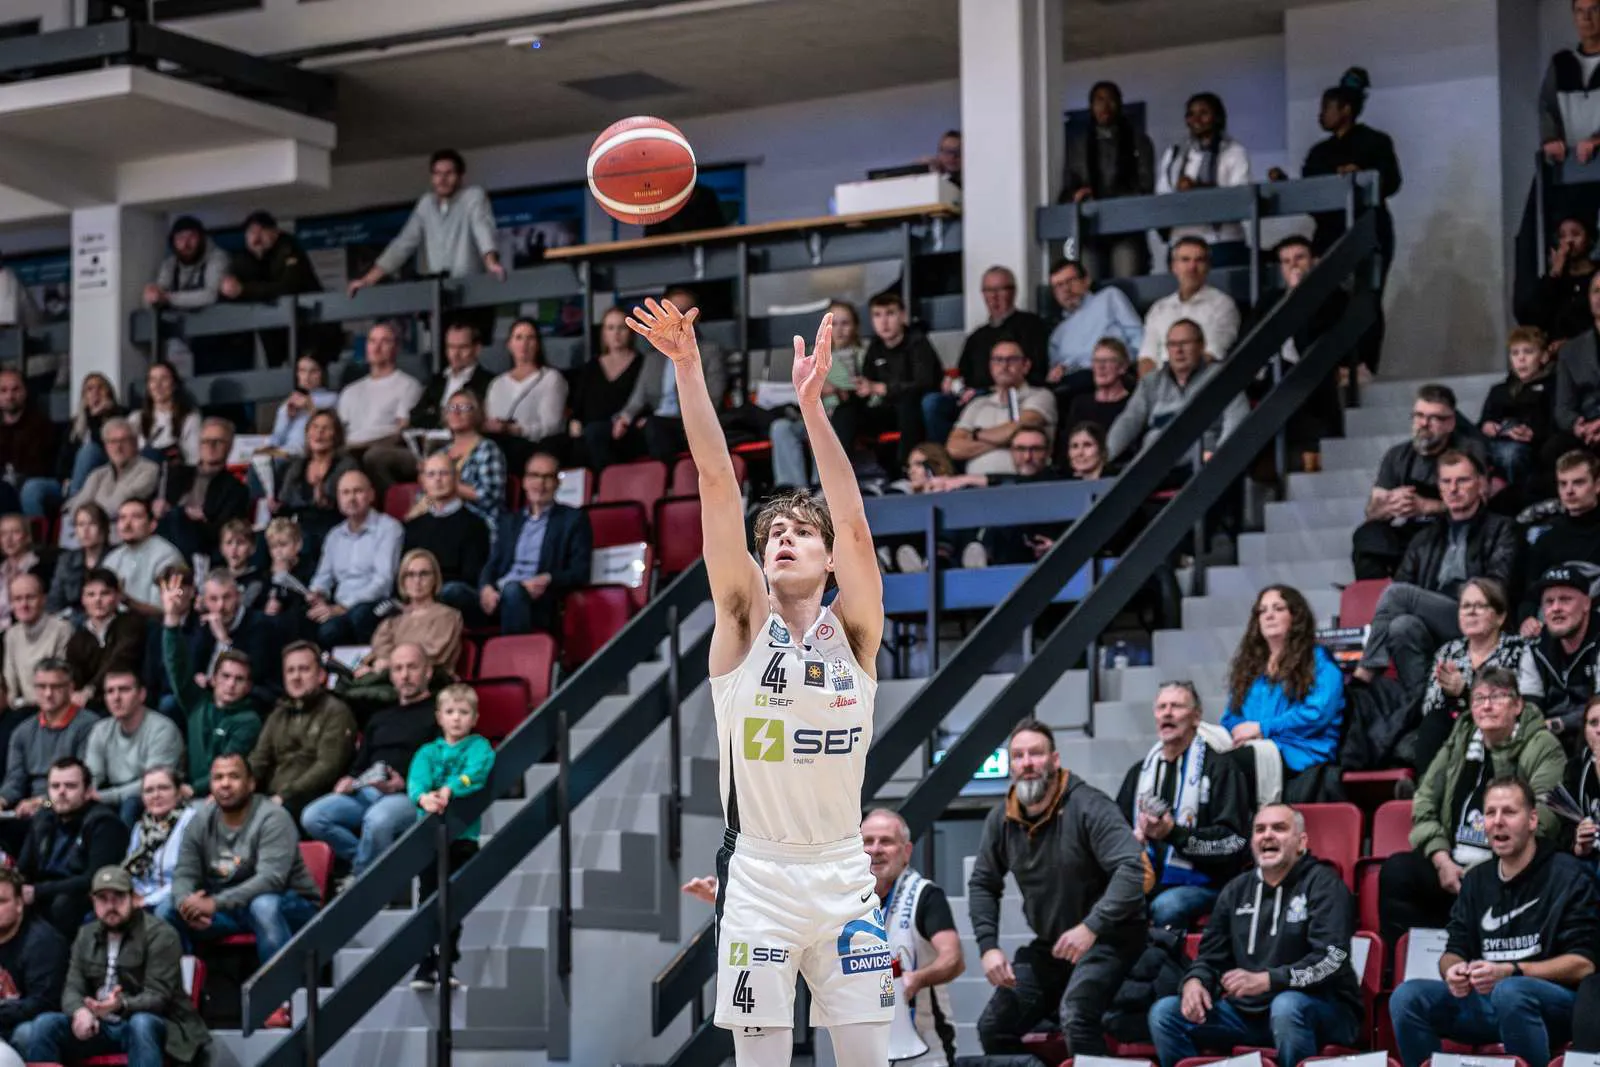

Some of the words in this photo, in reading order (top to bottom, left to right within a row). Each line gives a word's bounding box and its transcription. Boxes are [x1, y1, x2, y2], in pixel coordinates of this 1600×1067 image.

[760, 651, 788, 694] 4
[768, 697, 794, 706] SEF
[792, 726, 863, 755] SEF
[752, 947, 790, 963] SEF
[732, 970, 756, 1014] 4
